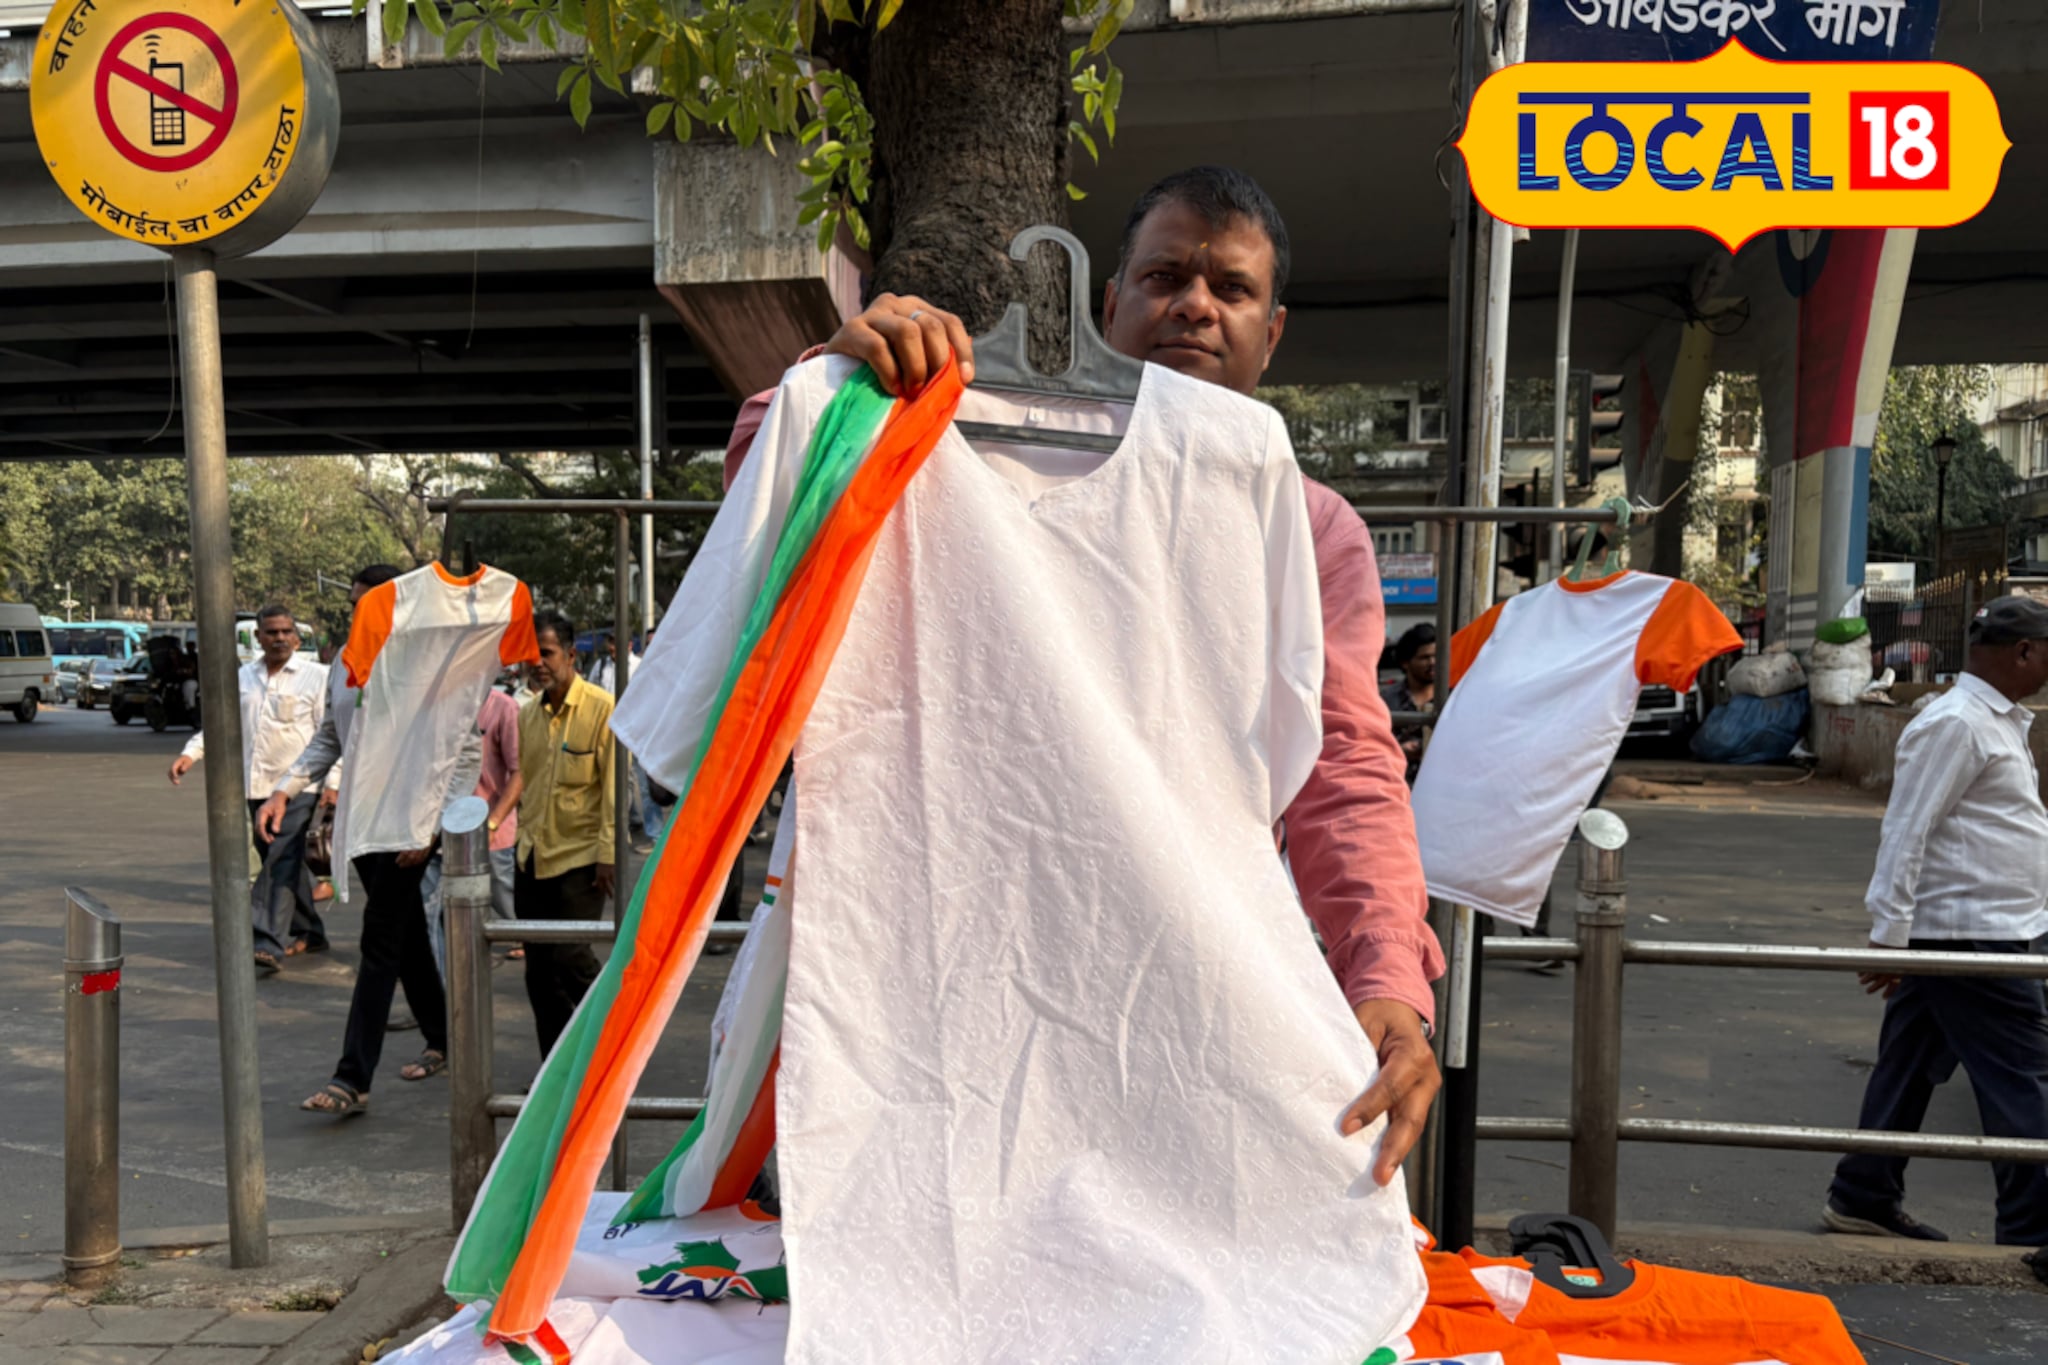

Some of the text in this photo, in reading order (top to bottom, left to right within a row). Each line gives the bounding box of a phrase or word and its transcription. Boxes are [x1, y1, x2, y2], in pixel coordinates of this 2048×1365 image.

[80, 104, 296, 238] मोबाईल चा वापर टाळा
